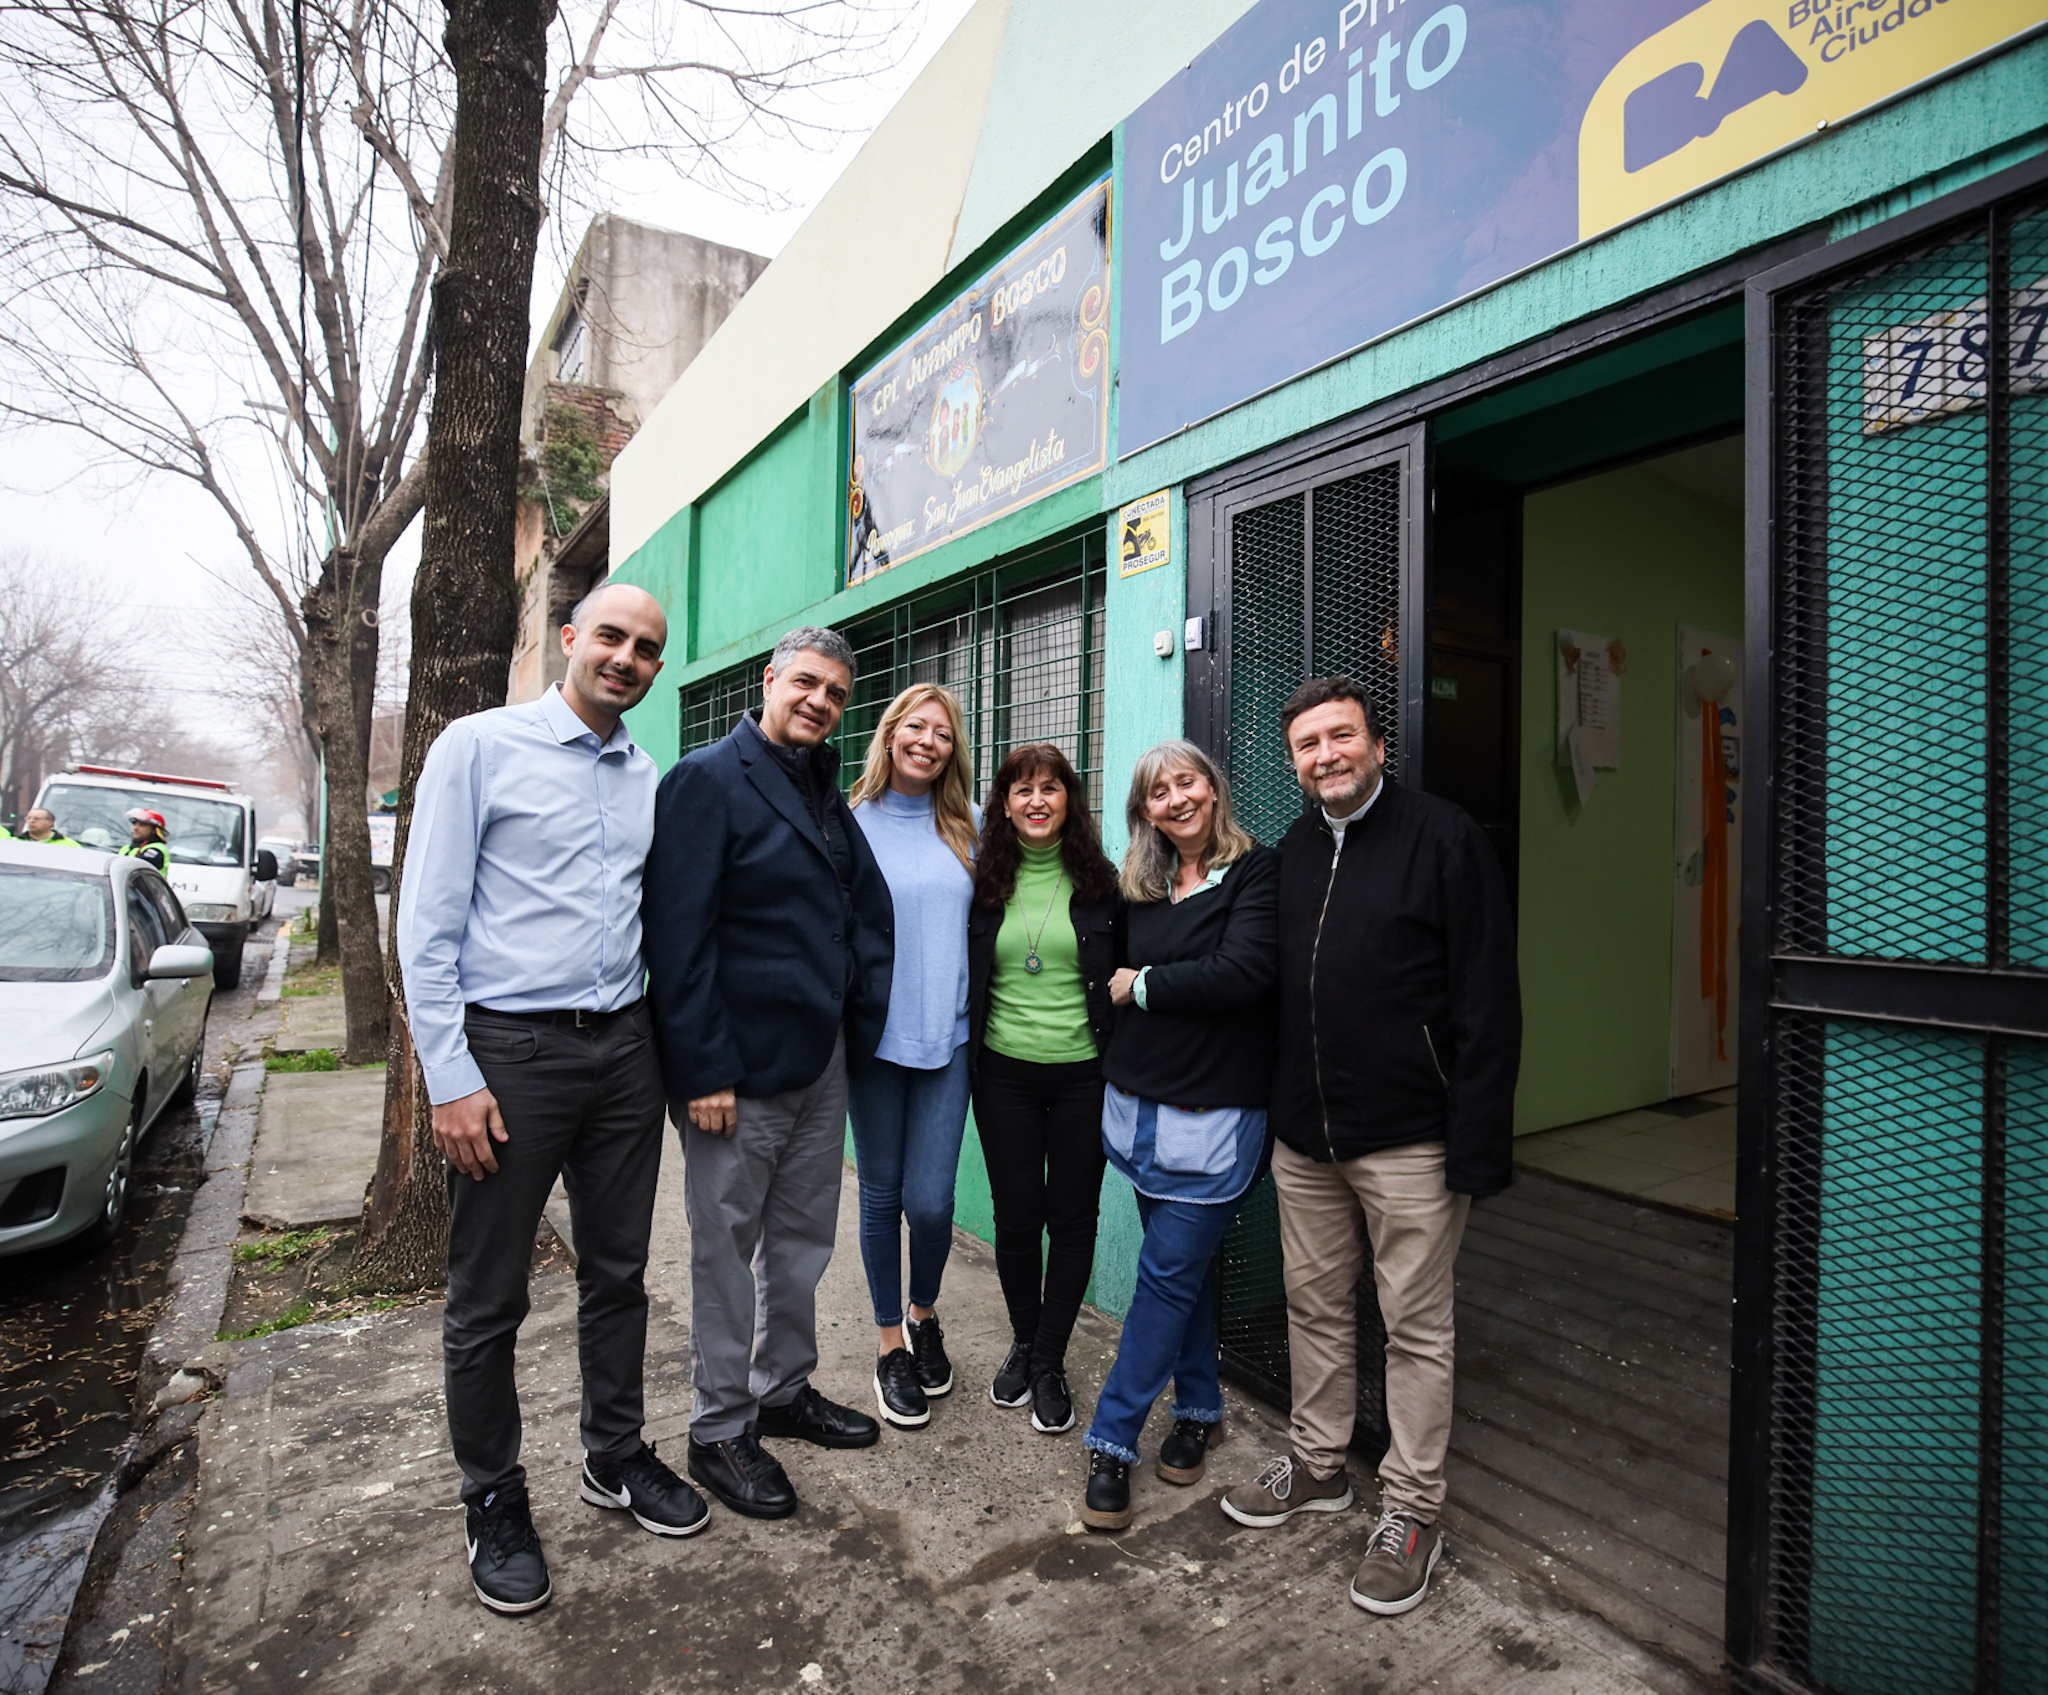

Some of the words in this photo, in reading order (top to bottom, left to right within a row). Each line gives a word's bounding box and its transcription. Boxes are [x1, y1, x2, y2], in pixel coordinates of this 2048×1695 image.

[1789, 0, 1841, 30] Bu
[1820, 0, 1950, 62] Ciuda
[1160, 82, 1269, 184] Centro
[1279, 36, 1326, 94] de
[1160, 4, 1467, 261] Juanito
[1624, 19, 1808, 174] BA
[1161, 147, 1407, 345] Bosco
[906, 312, 982, 393] JUANITO
[992, 246, 1066, 330] BOSCO
[923, 495, 947, 534] San
[947, 480, 979, 526] Juan
[979, 427, 1066, 505] Evangelista
[1123, 496, 1165, 519] CONECTADA
[1122, 549, 1166, 572] PROSEGUR
